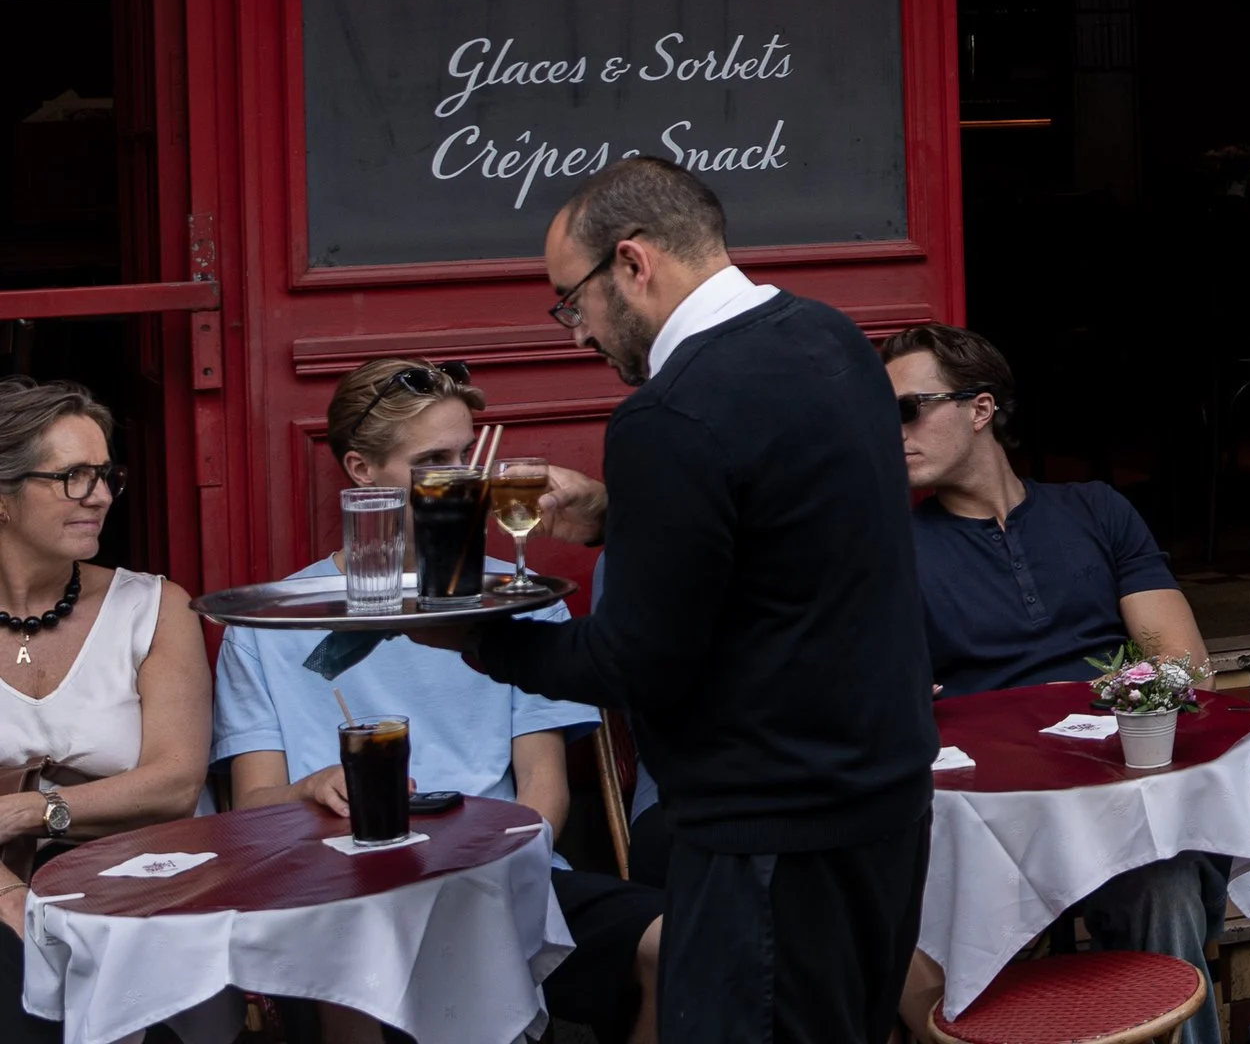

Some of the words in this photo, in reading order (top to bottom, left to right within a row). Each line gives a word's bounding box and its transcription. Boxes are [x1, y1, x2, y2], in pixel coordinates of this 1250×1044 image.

[434, 37, 587, 118] Glaces
[600, 57, 632, 83] &
[638, 32, 794, 82] Sorbets
[431, 124, 609, 210] Crêpes
[659, 119, 789, 173] Snack
